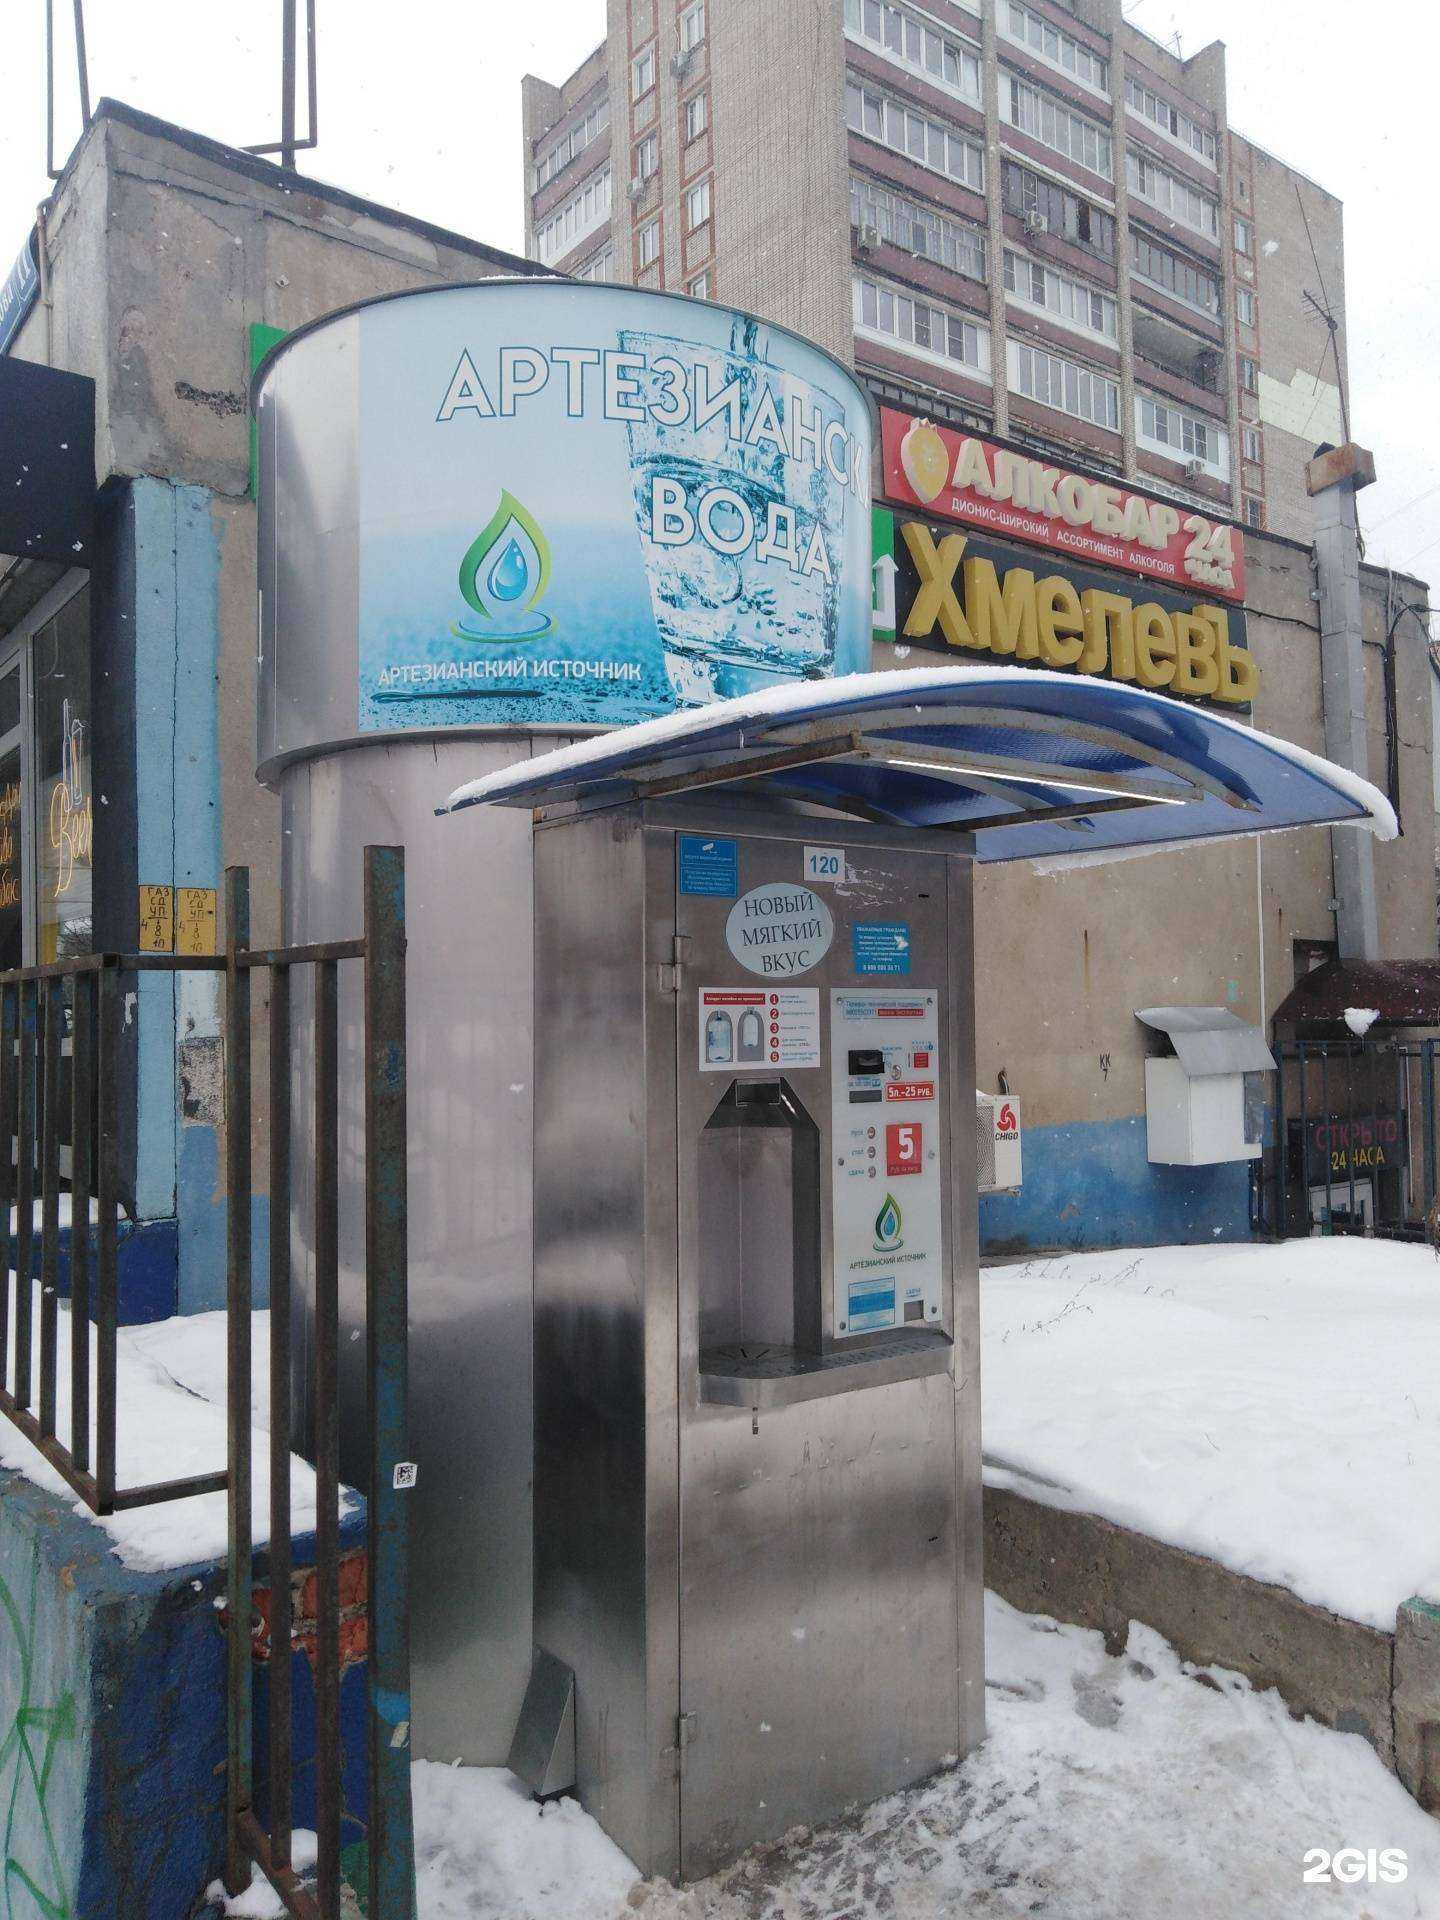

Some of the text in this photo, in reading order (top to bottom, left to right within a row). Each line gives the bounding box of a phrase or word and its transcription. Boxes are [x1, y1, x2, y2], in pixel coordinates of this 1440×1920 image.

[952, 438, 1235, 572] АЛКОБАР 24
[651, 476, 834, 586] ВОДА
[1056, 530, 1125, 561] АССОРТИМЕНТ
[1129, 554, 1176, 575] АЛКОГОЛЯ
[378, 656, 642, 686] АРТЕЗИАНСКИЙ ИСТОЧНИК
[810, 855, 839, 874] 120
[147, 887, 170, 897] ГАЗ
[187, 890, 208, 900] ГАЗ
[744, 891, 814, 917] НОВЫЙ
[742, 918, 822, 946] МЯГКИЙ
[761, 950, 810, 973] ВКУС
[899, 1127, 914, 1161] 5
[995, 1131, 1018, 1141] CHIGO
[1331, 1150, 1347, 1170] 24
[850, 1252, 927, 1270] АРТЕЗИАНСКИЙ ИСТОЧНИК
